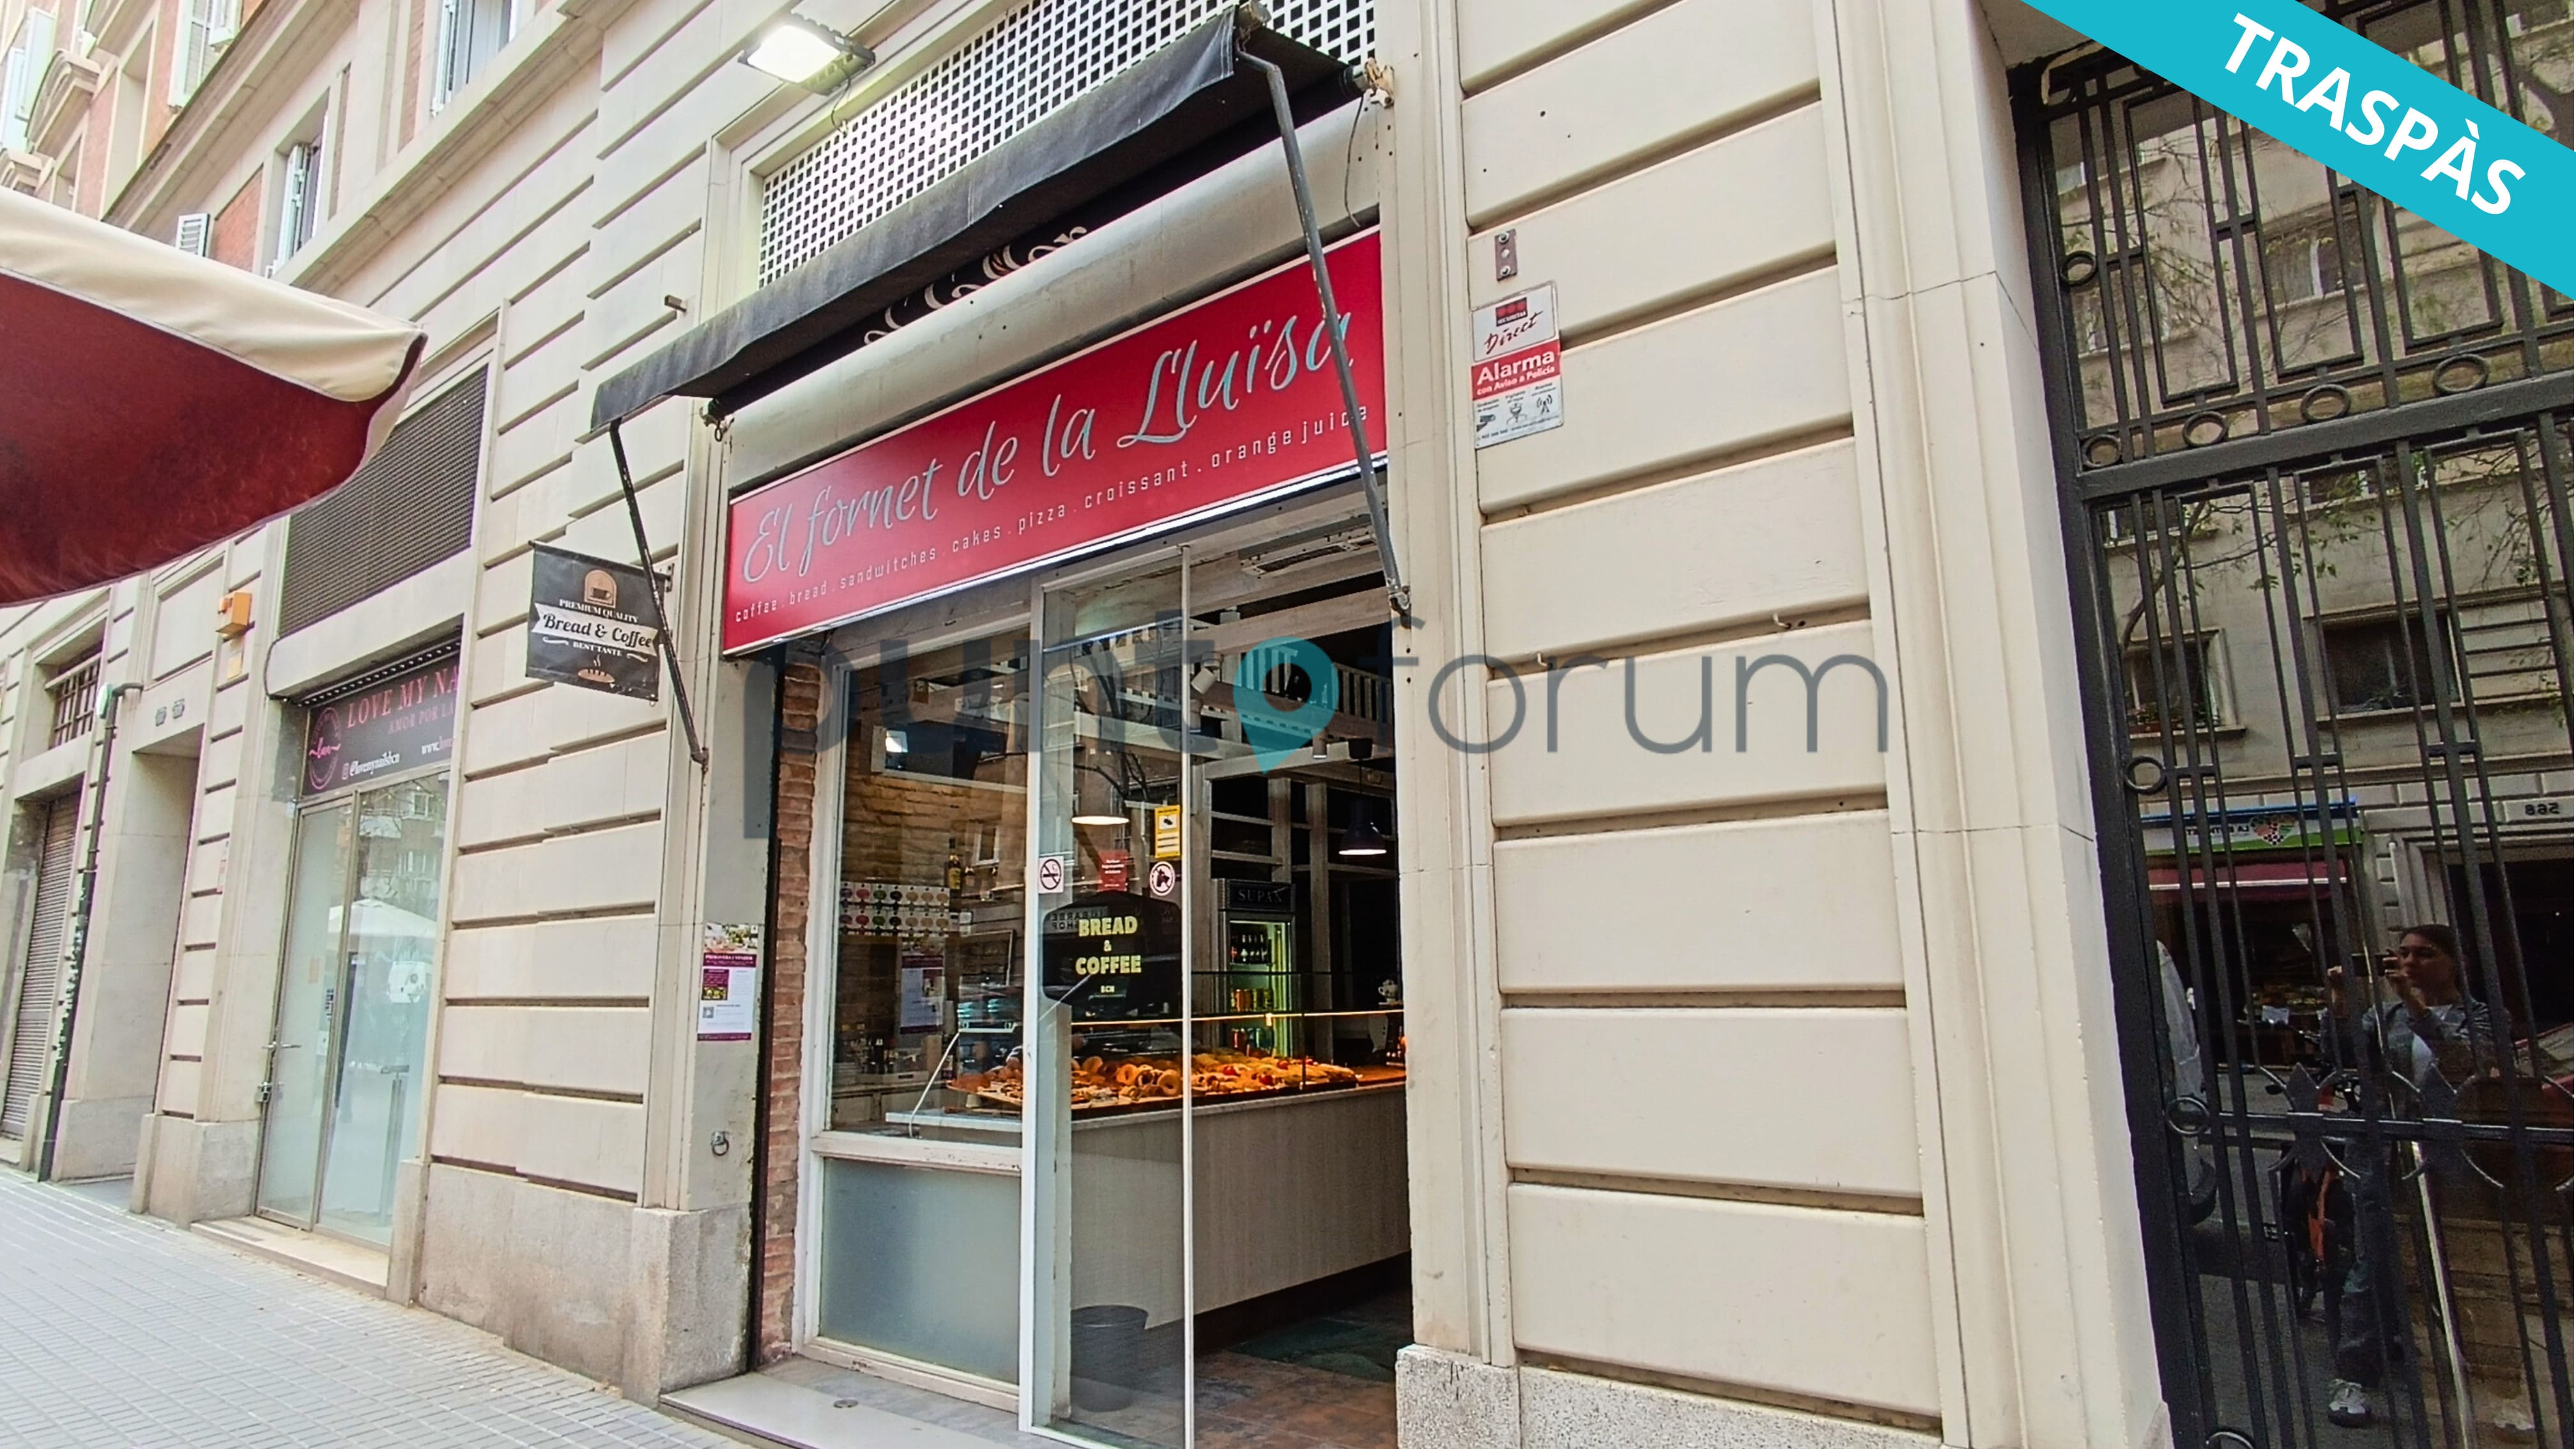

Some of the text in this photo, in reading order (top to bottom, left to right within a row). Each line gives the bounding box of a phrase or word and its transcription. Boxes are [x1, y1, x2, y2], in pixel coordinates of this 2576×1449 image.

[1484, 310, 1544, 355] Direct
[1477, 351, 1555, 385] Alarma
[1476, 383, 1492, 395] con
[743, 503, 793, 583] El
[799, 458, 944, 577] fornet
[958, 420, 1018, 500] de
[1042, 394, 1096, 477] la
[736, 599, 777, 622] coffee
[790, 580, 827, 604] bread
[839, 548, 937, 590] sandwitches
[952, 526, 1001, 553] cakes
[1018, 504, 1066, 535] pizza
[1084, 461, 1188, 509] croissant
[1211, 431, 1292, 468] orange
[543, 613, 652, 648] Bread & Coffee
[347, 689, 393, 729] LOVE
[398, 675, 428, 711] MY
[1078, 916, 1138, 937] BREAD
[1103, 940, 1112, 952] &
[1075, 955, 1142, 976] COFFEE
